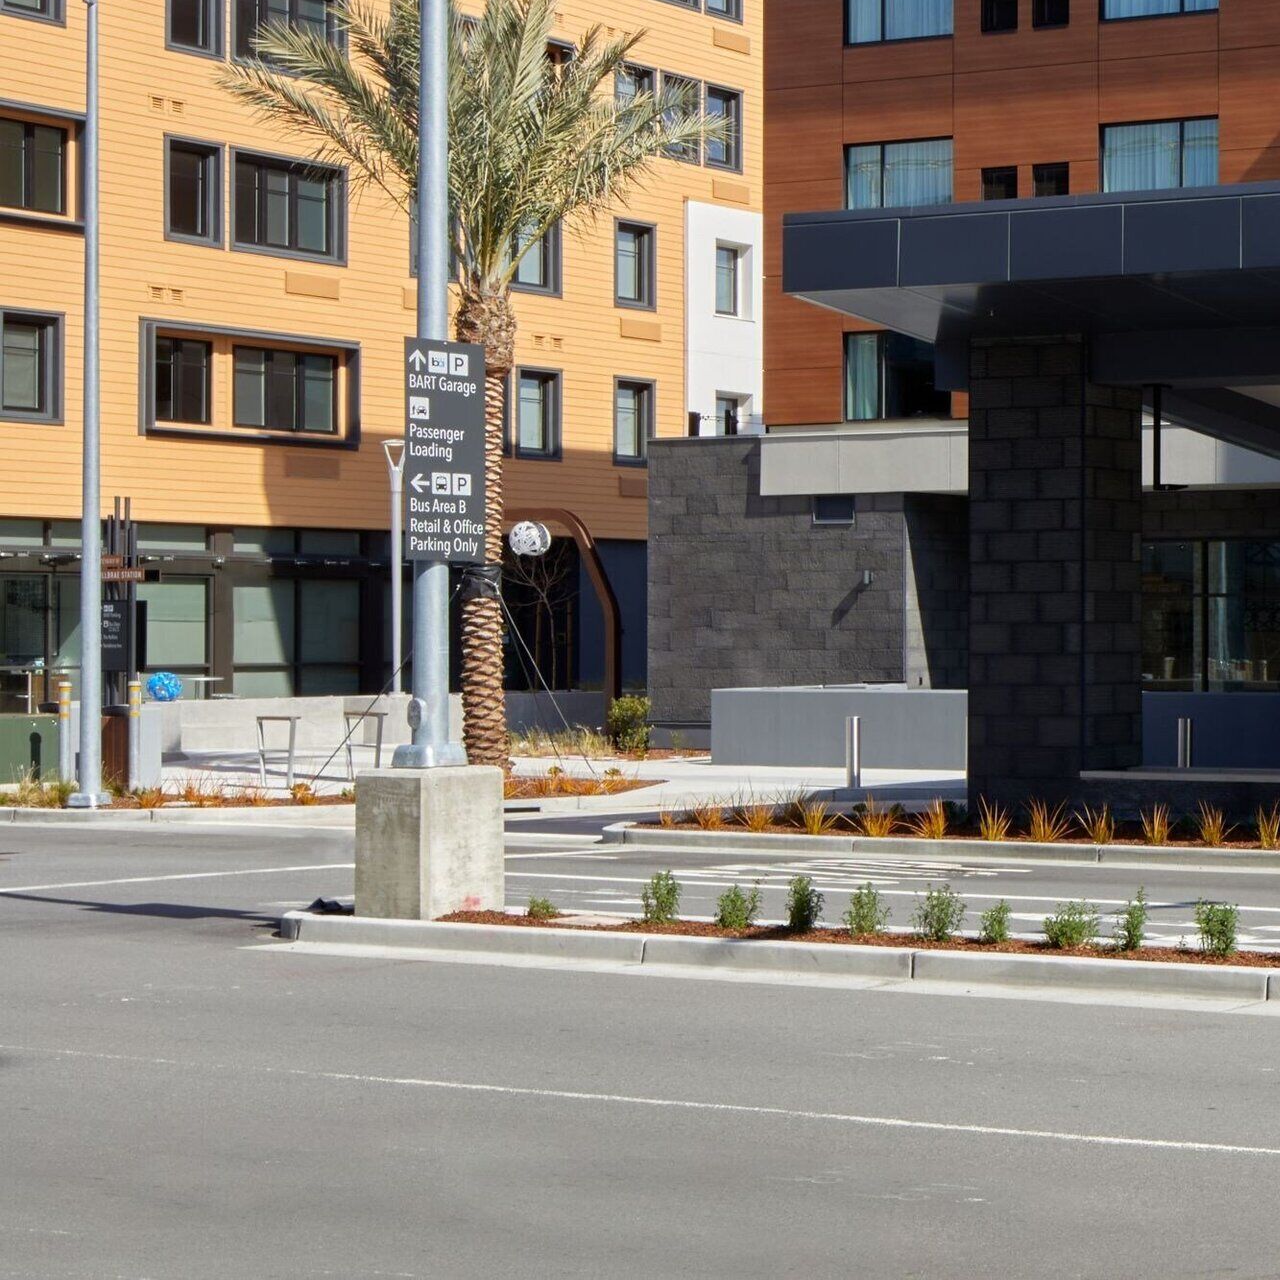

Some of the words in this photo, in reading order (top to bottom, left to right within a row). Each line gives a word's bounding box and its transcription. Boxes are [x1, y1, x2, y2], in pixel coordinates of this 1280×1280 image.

[409, 373, 437, 390] BART
[438, 376, 477, 397] Garage
[409, 423, 465, 444] Passenger
[409, 441, 453, 462] Loading
[410, 497, 431, 513] Bus
[432, 498, 456, 513] Area
[459, 499, 467, 513] B
[410, 518, 440, 533] Retail
[443, 518, 452, 534] &
[453, 519, 484, 535] Office
[410, 536, 451, 556] Parking
[453, 537, 478, 556] Only
